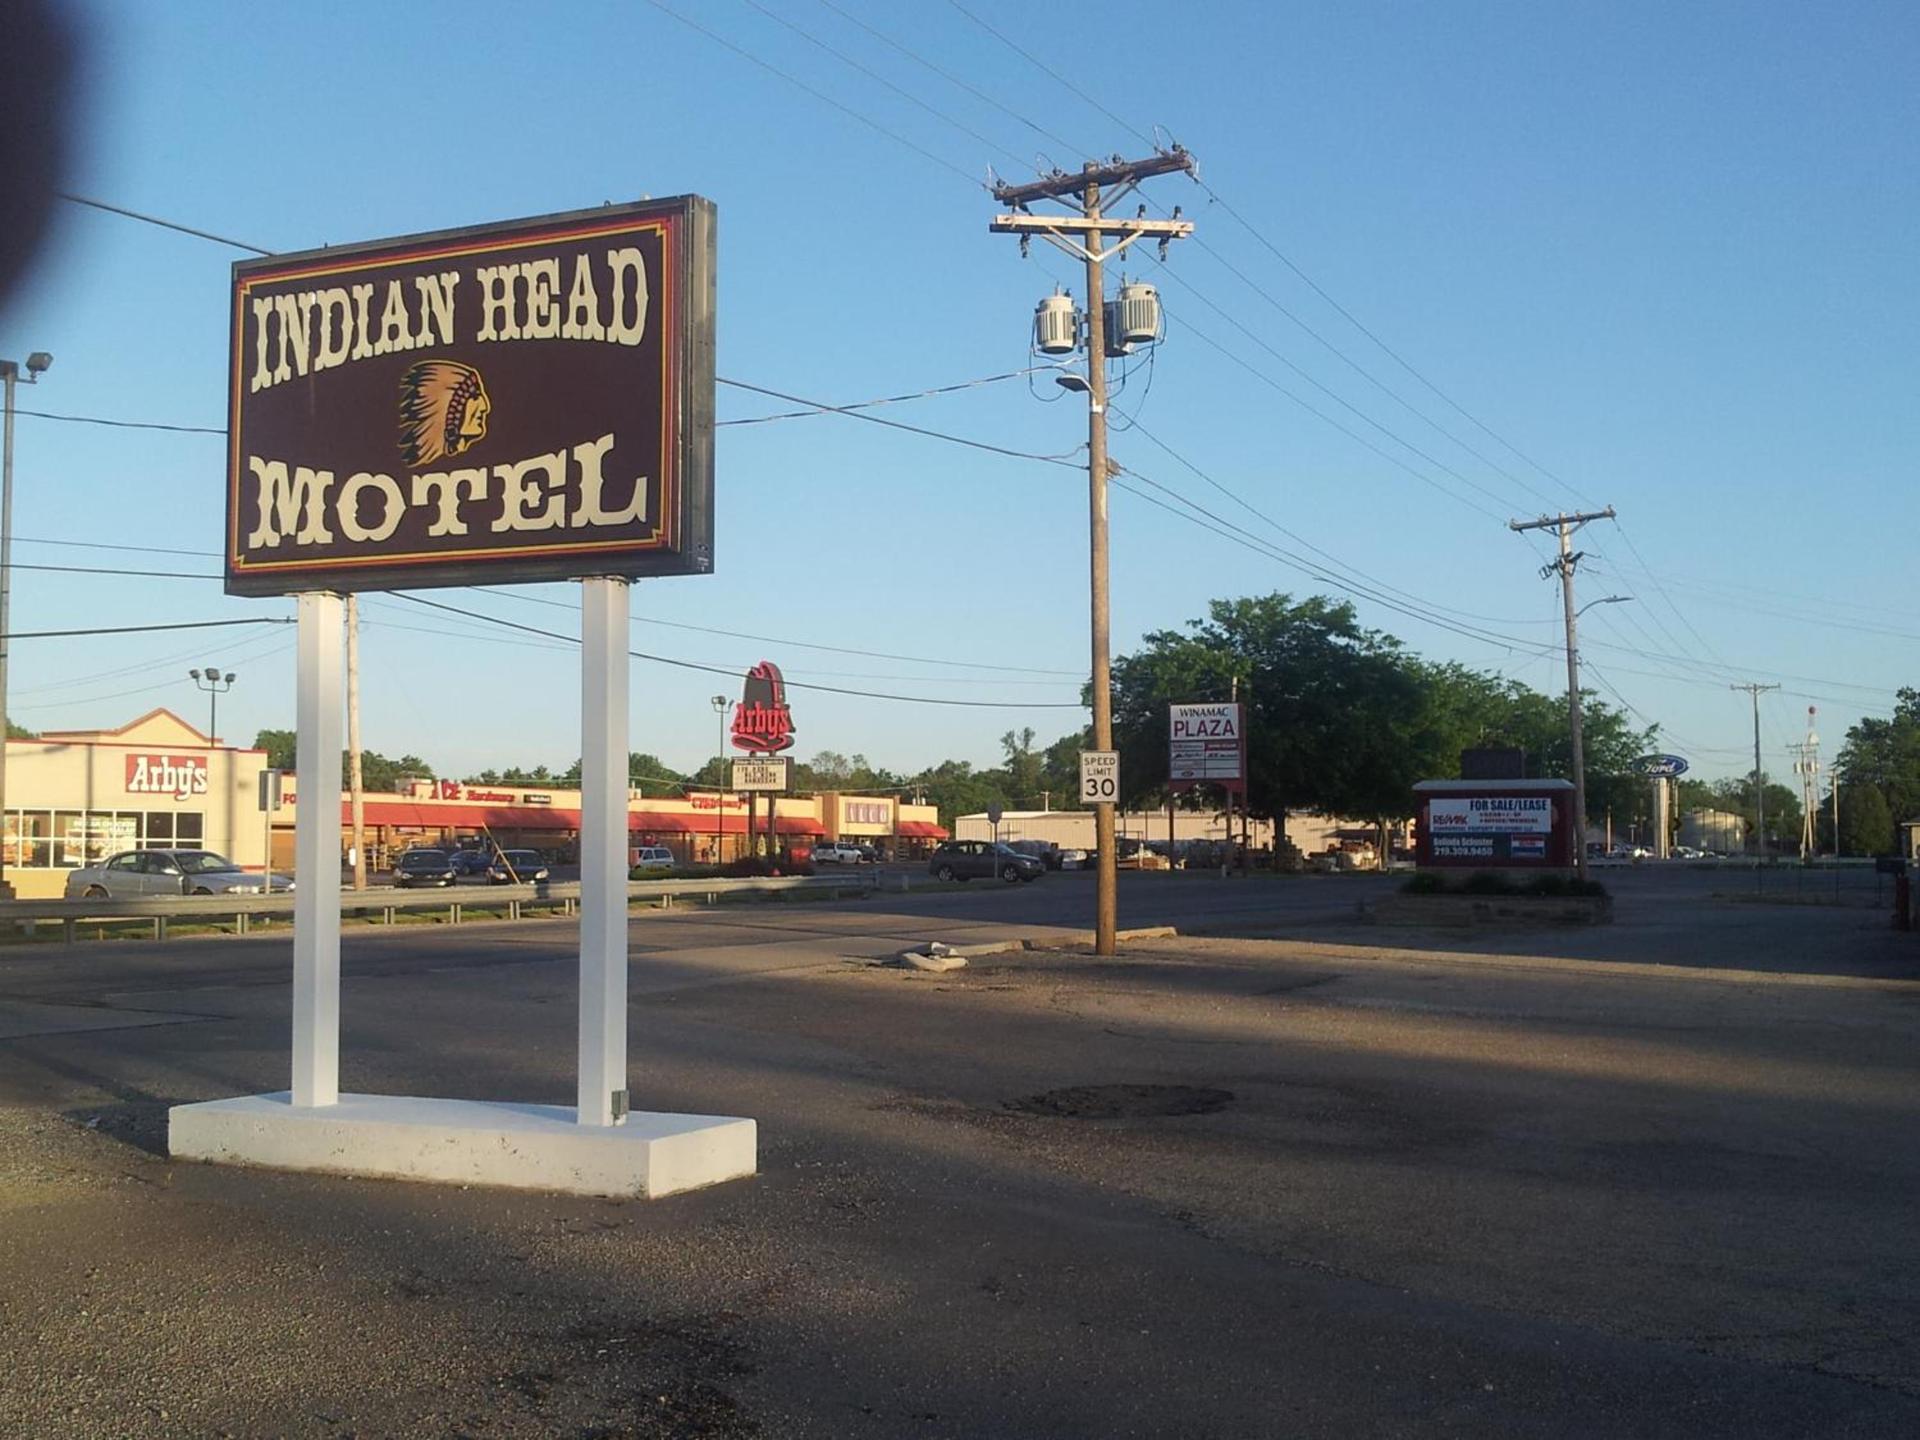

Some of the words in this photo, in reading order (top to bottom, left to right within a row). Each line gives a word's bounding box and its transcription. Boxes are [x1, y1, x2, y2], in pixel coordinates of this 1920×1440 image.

[251, 271, 460, 394] INDIAN
[476, 247, 649, 347] HEAD
[248, 433, 648, 549] MOTEL
[1180, 706, 1230, 717] WINAMAC
[1174, 719, 1235, 737] PLAZA
[1084, 757, 1116, 766] SPEED
[1641, 759, 1677, 773] Ford
[128, 756, 208, 801] Arby's
[1087, 767, 1112, 776] LIMIT
[1085, 778, 1115, 797] 30
[1470, 799, 1489, 811] FOR
[1491, 799, 1547, 811] SALE/LEASE
